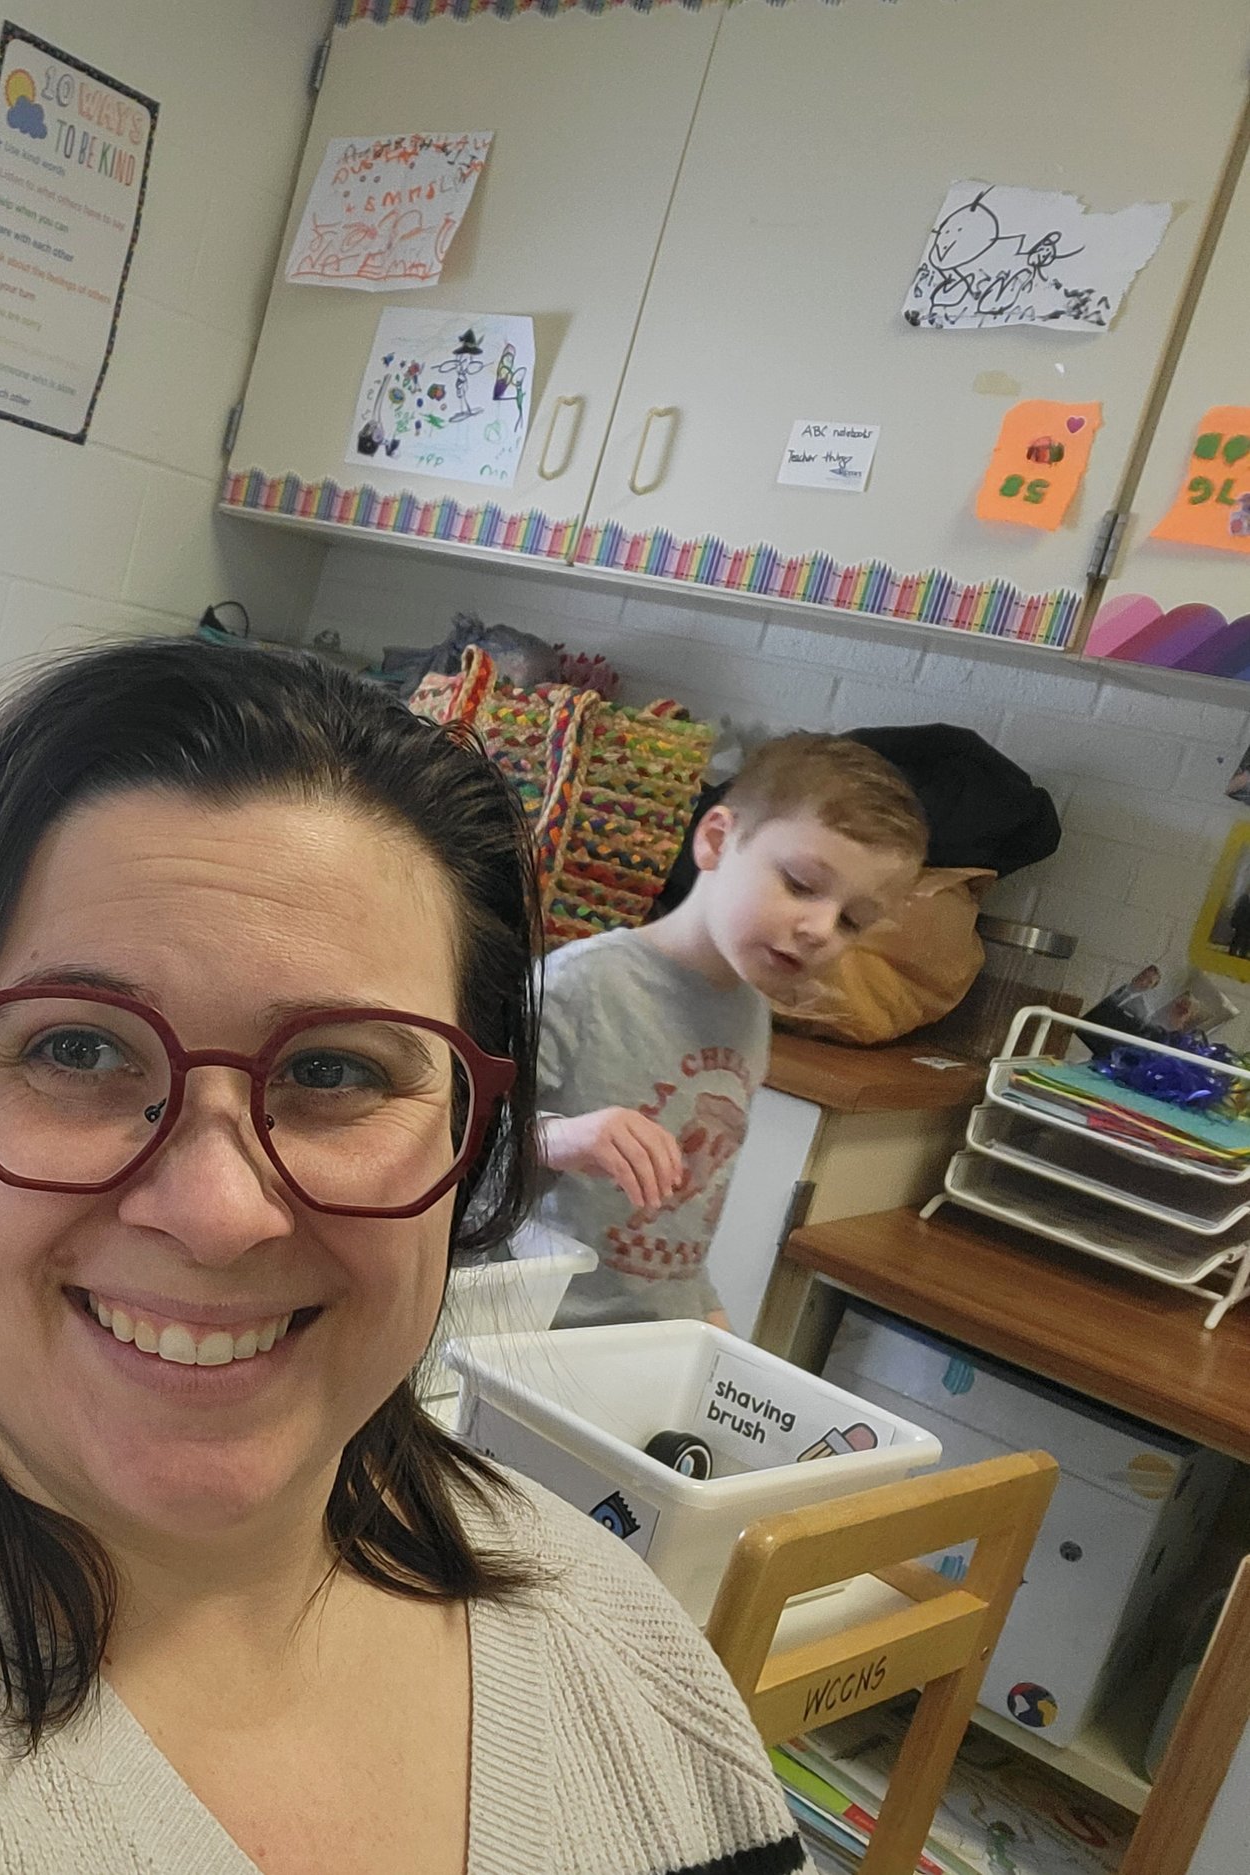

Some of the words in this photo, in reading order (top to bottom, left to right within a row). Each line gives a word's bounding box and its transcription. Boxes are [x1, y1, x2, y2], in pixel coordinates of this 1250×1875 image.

[77, 82, 144, 145] WAYS
[54, 119, 76, 159] TO
[78, 131, 98, 169] BE
[98, 141, 136, 186] KIND
[801, 424, 828, 438] ABC
[833, 426, 873, 439] notebooks
[706, 1400, 767, 1445] brush
[713, 1379, 797, 1434] shaving
